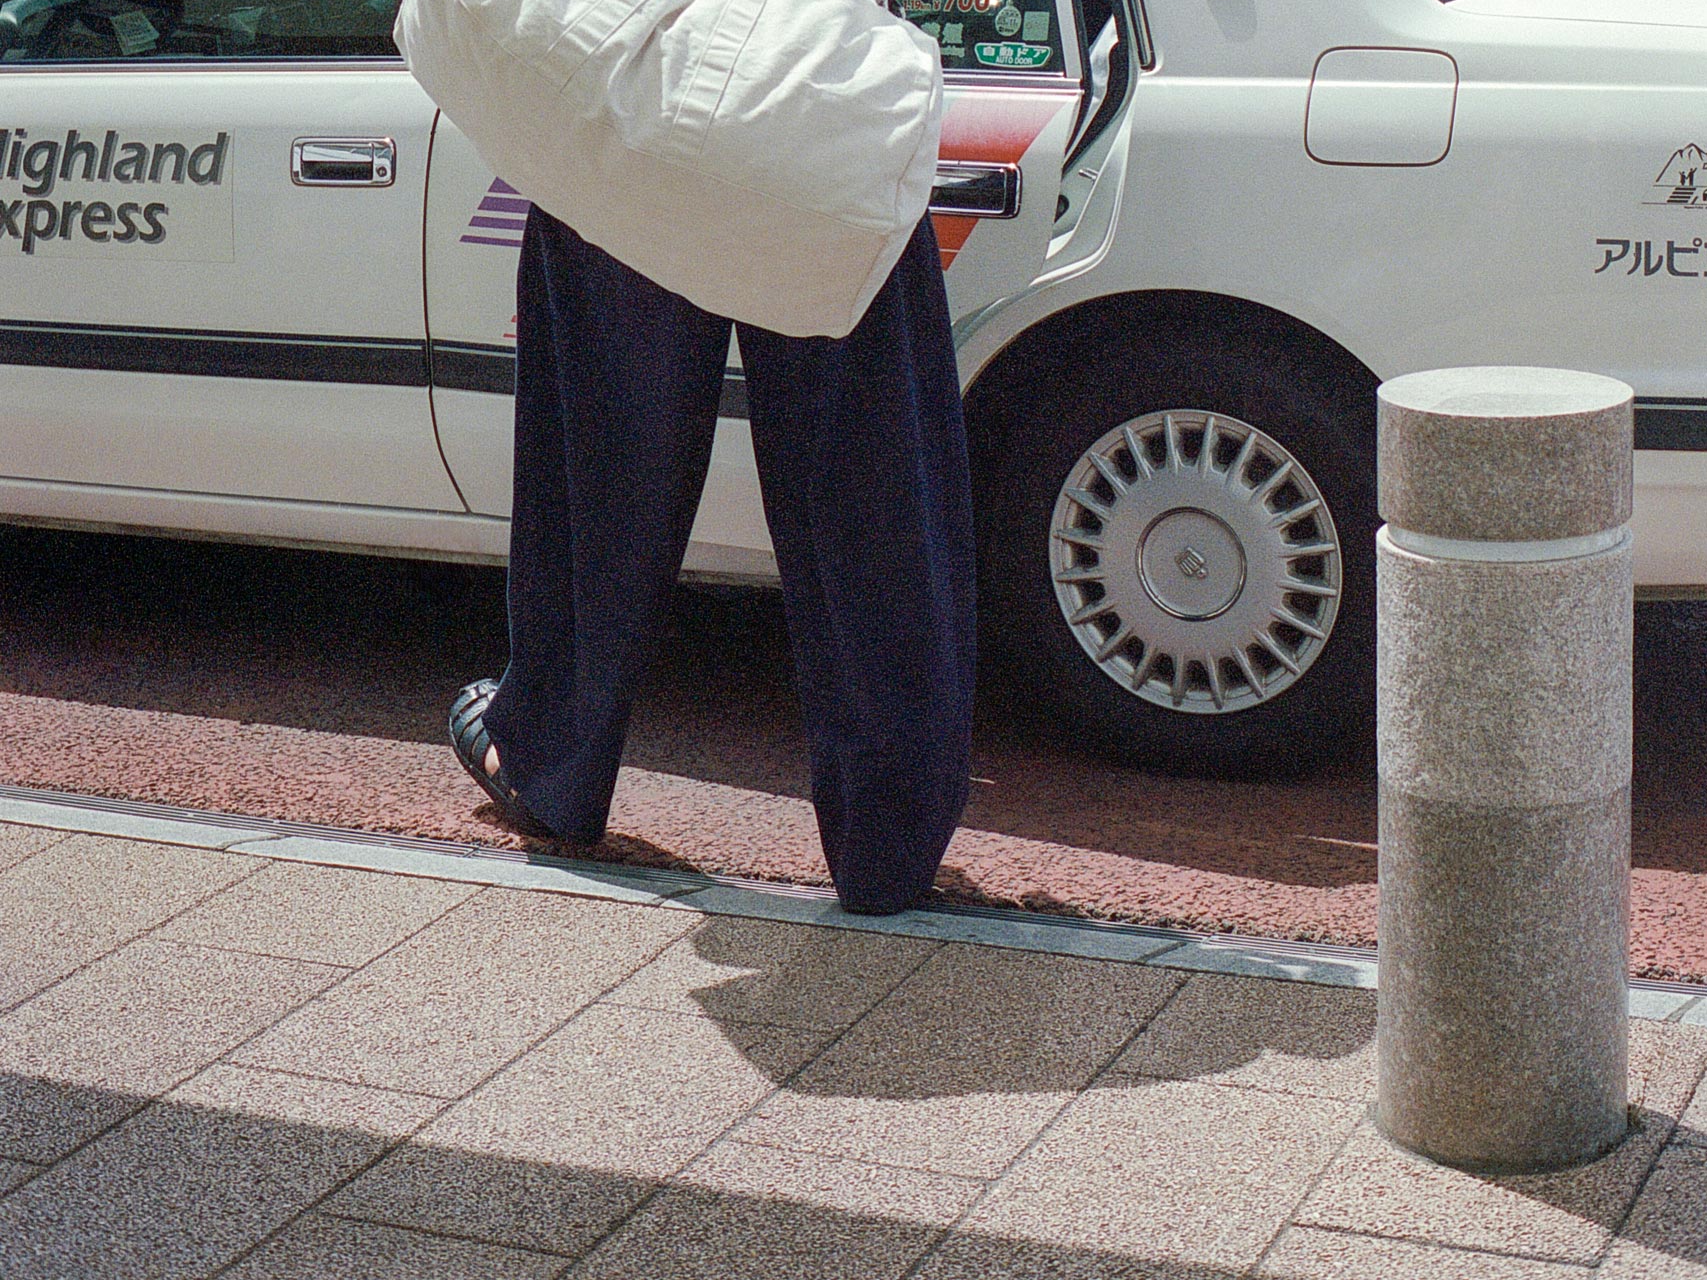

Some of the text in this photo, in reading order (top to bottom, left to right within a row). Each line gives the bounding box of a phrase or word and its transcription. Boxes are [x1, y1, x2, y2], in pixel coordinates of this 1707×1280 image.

[982, 46, 1047, 58] 自動ドア
[995, 56, 1033, 65] AUTO DOOR
[1594, 237, 1707, 277] アルピ
